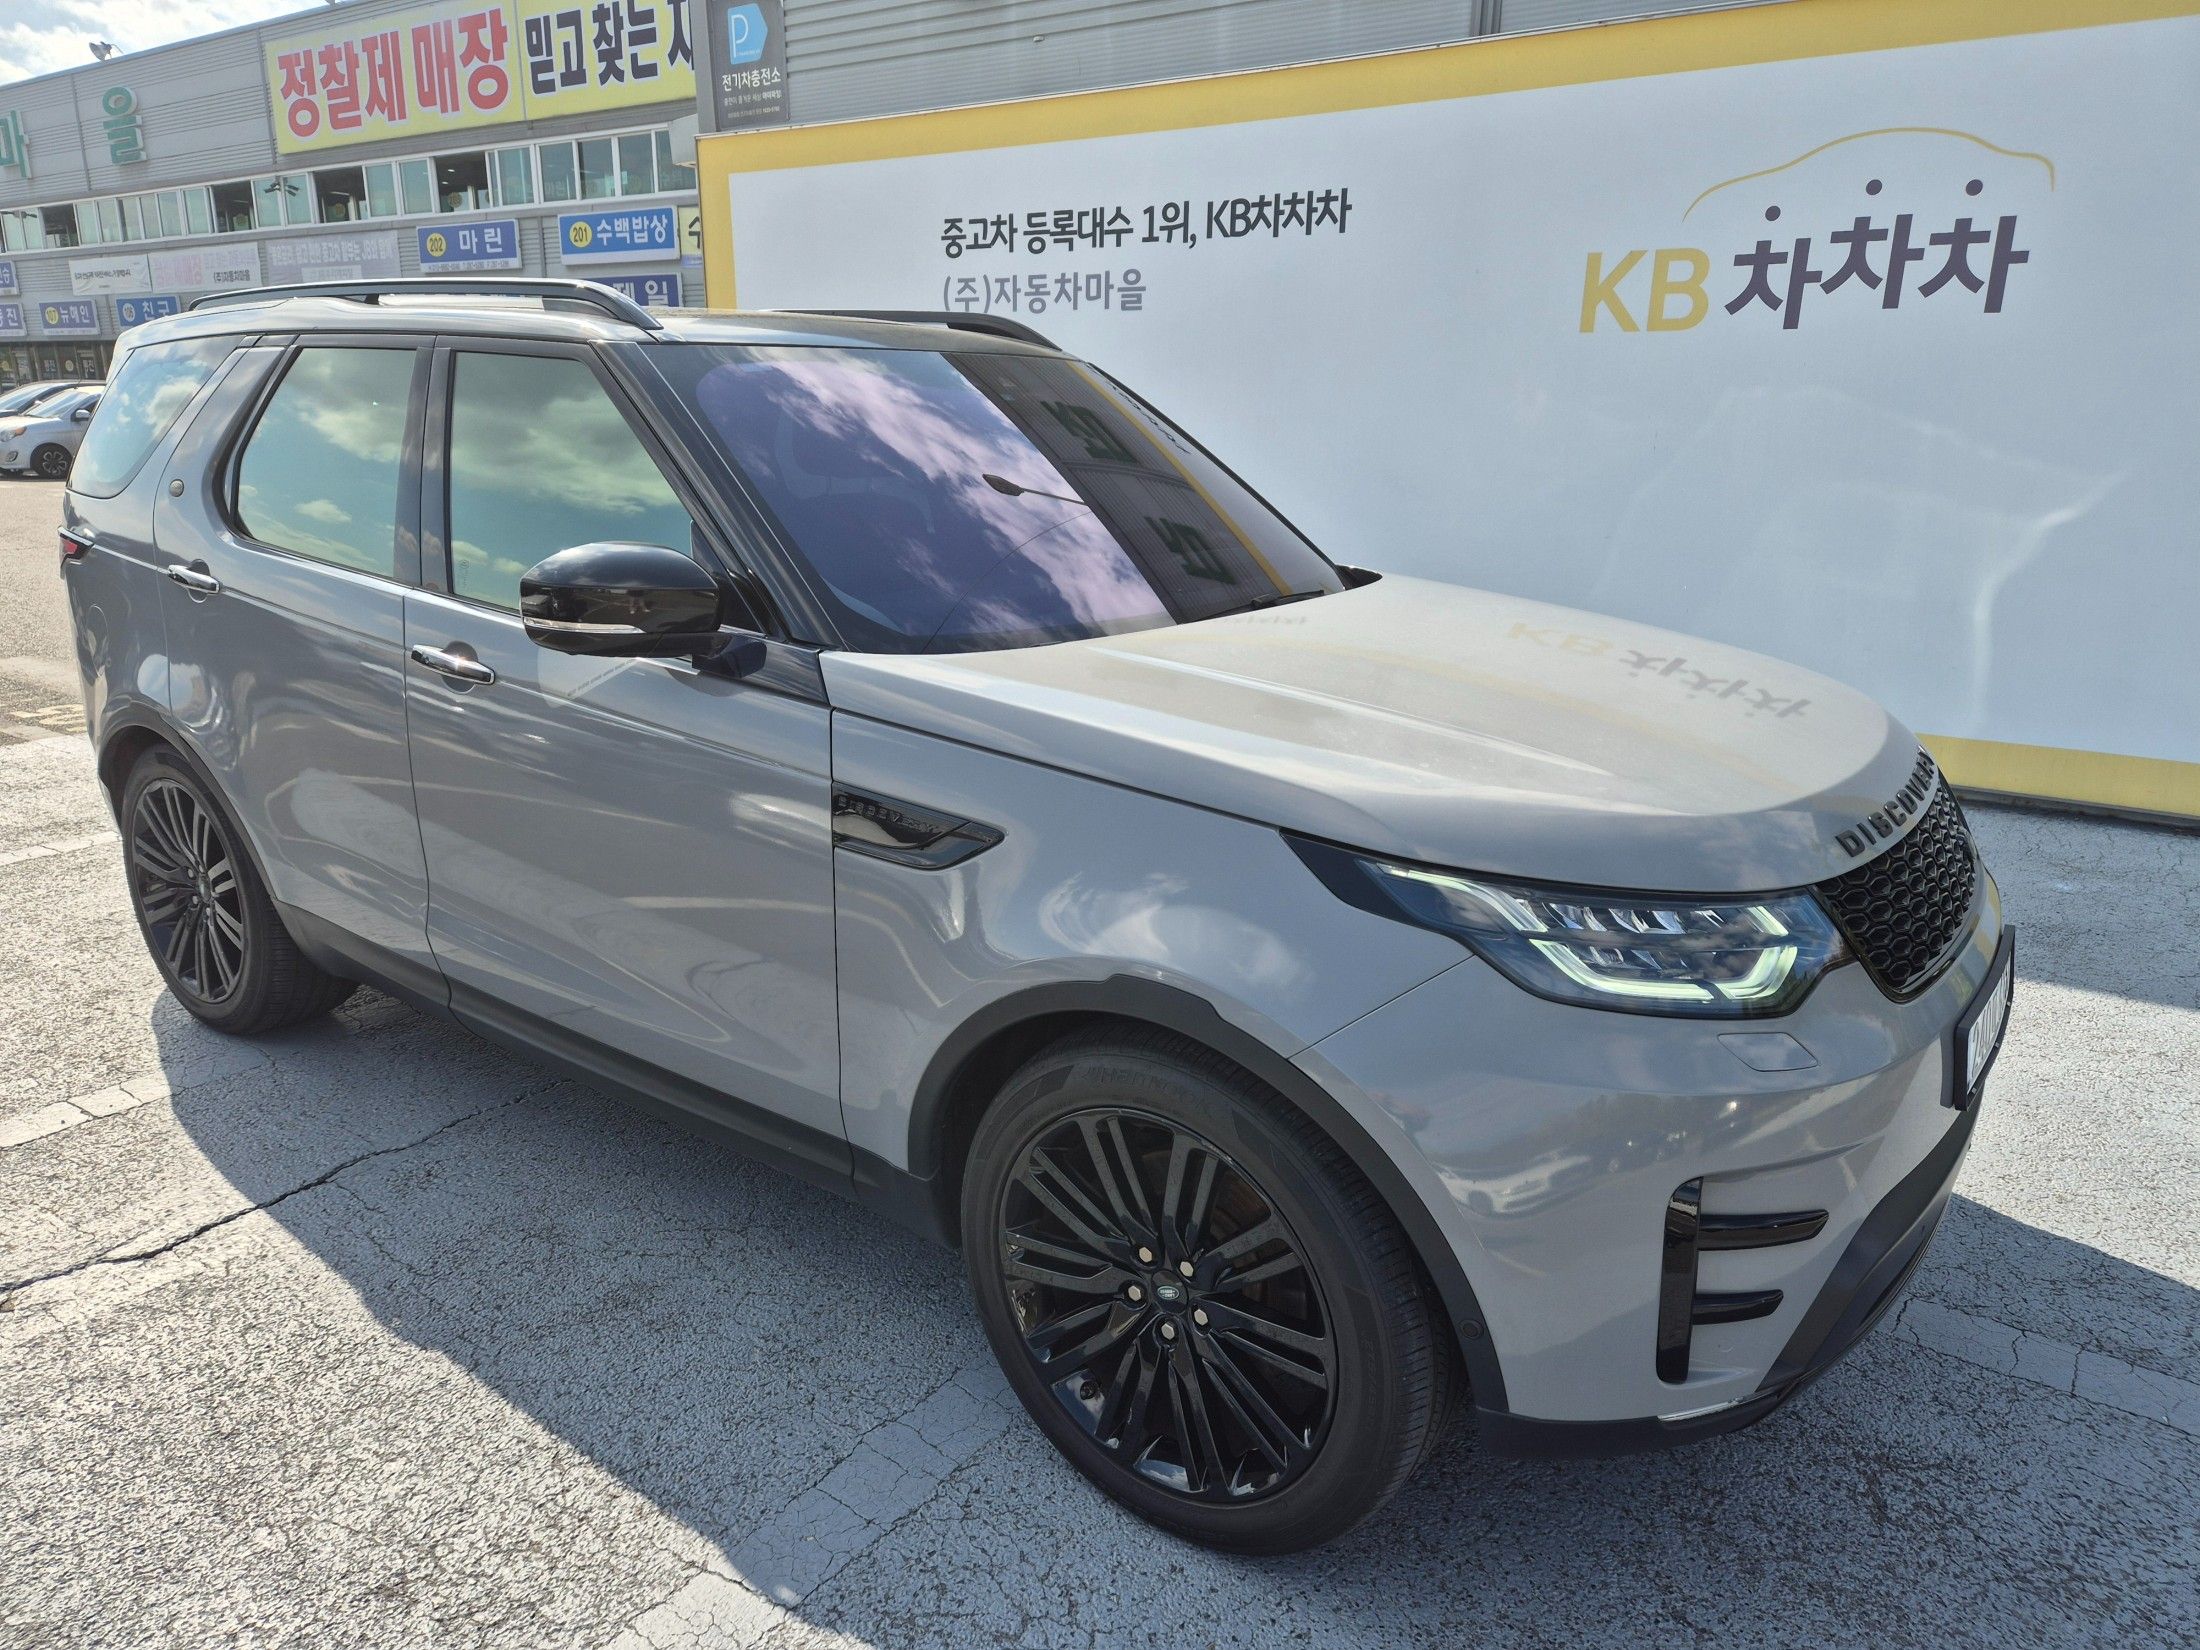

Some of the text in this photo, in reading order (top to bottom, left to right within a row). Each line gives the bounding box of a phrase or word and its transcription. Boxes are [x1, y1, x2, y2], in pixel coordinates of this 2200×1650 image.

[277, 30, 407, 138] 정찰제
[411, 7, 509, 114] 매장
[525, 9, 587, 95] 믿고
[592, 0, 658, 86] 찾는
[722, 66, 782, 92] 전기차충전소
[429, 237, 444, 252] 202
[572, 214, 668, 246] 201 수백밥상
[940, 187, 1353, 259] 중고차 등록대수 1위, KB차차차
[942, 268, 1148, 315] (주)자동차마을
[1835, 744, 1937, 858] DISCOVER
